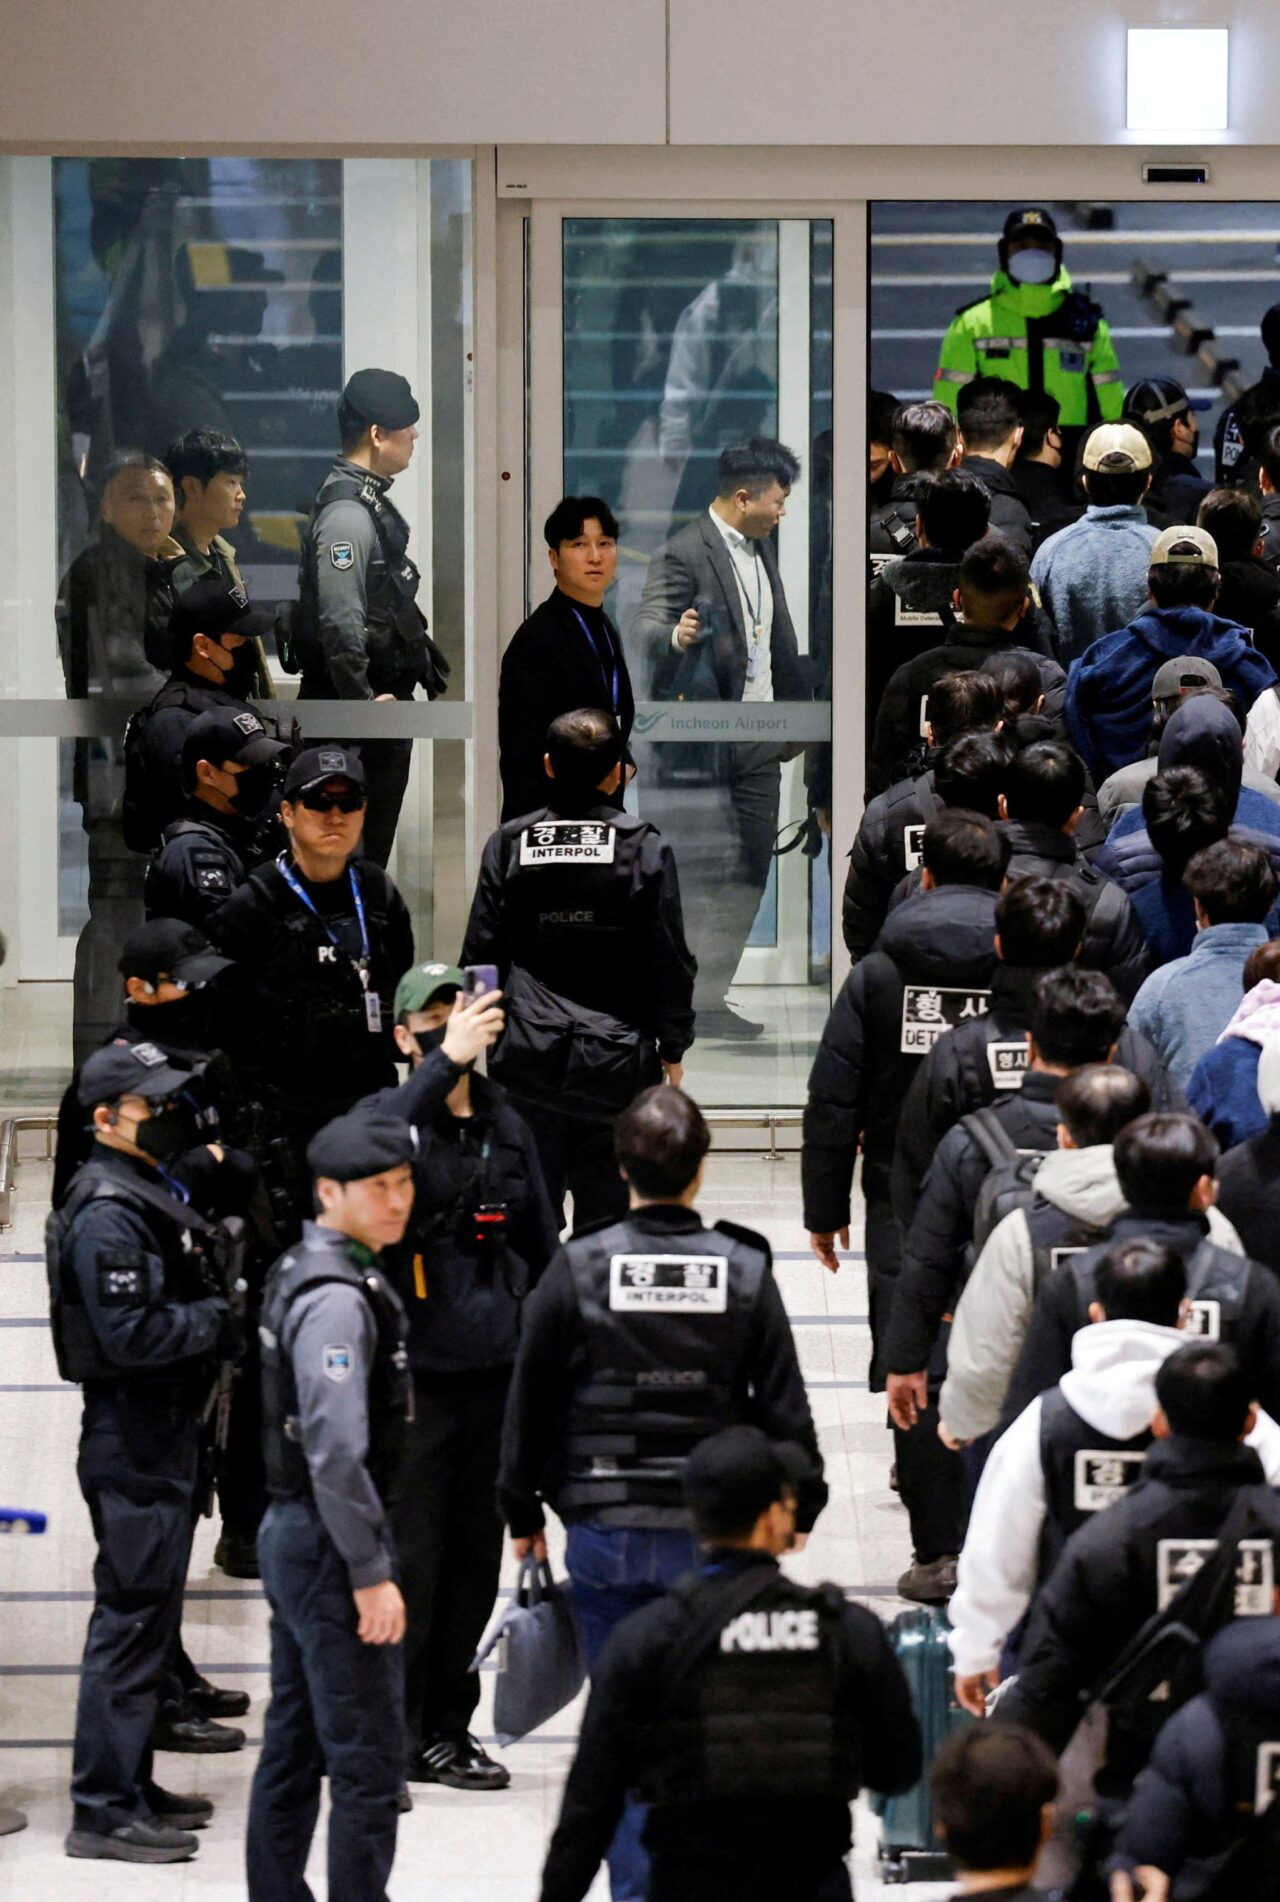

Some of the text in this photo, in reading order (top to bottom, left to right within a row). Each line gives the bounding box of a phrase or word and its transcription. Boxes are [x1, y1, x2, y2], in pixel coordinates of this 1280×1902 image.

[670, 717, 788, 731] Incheon Airport
[533, 826, 604, 845] 경찰
[532, 847, 601, 858] INTERPOL
[539, 910, 594, 923] POLICE
[906, 1029, 938, 1046] DET
[998, 1052, 1029, 1069] 형사
[625, 1262, 714, 1288] 경찰
[626, 1291, 709, 1303] INTERPOL
[637, 1370, 705, 1384] POLICE
[720, 1609, 819, 1653] POLICE
